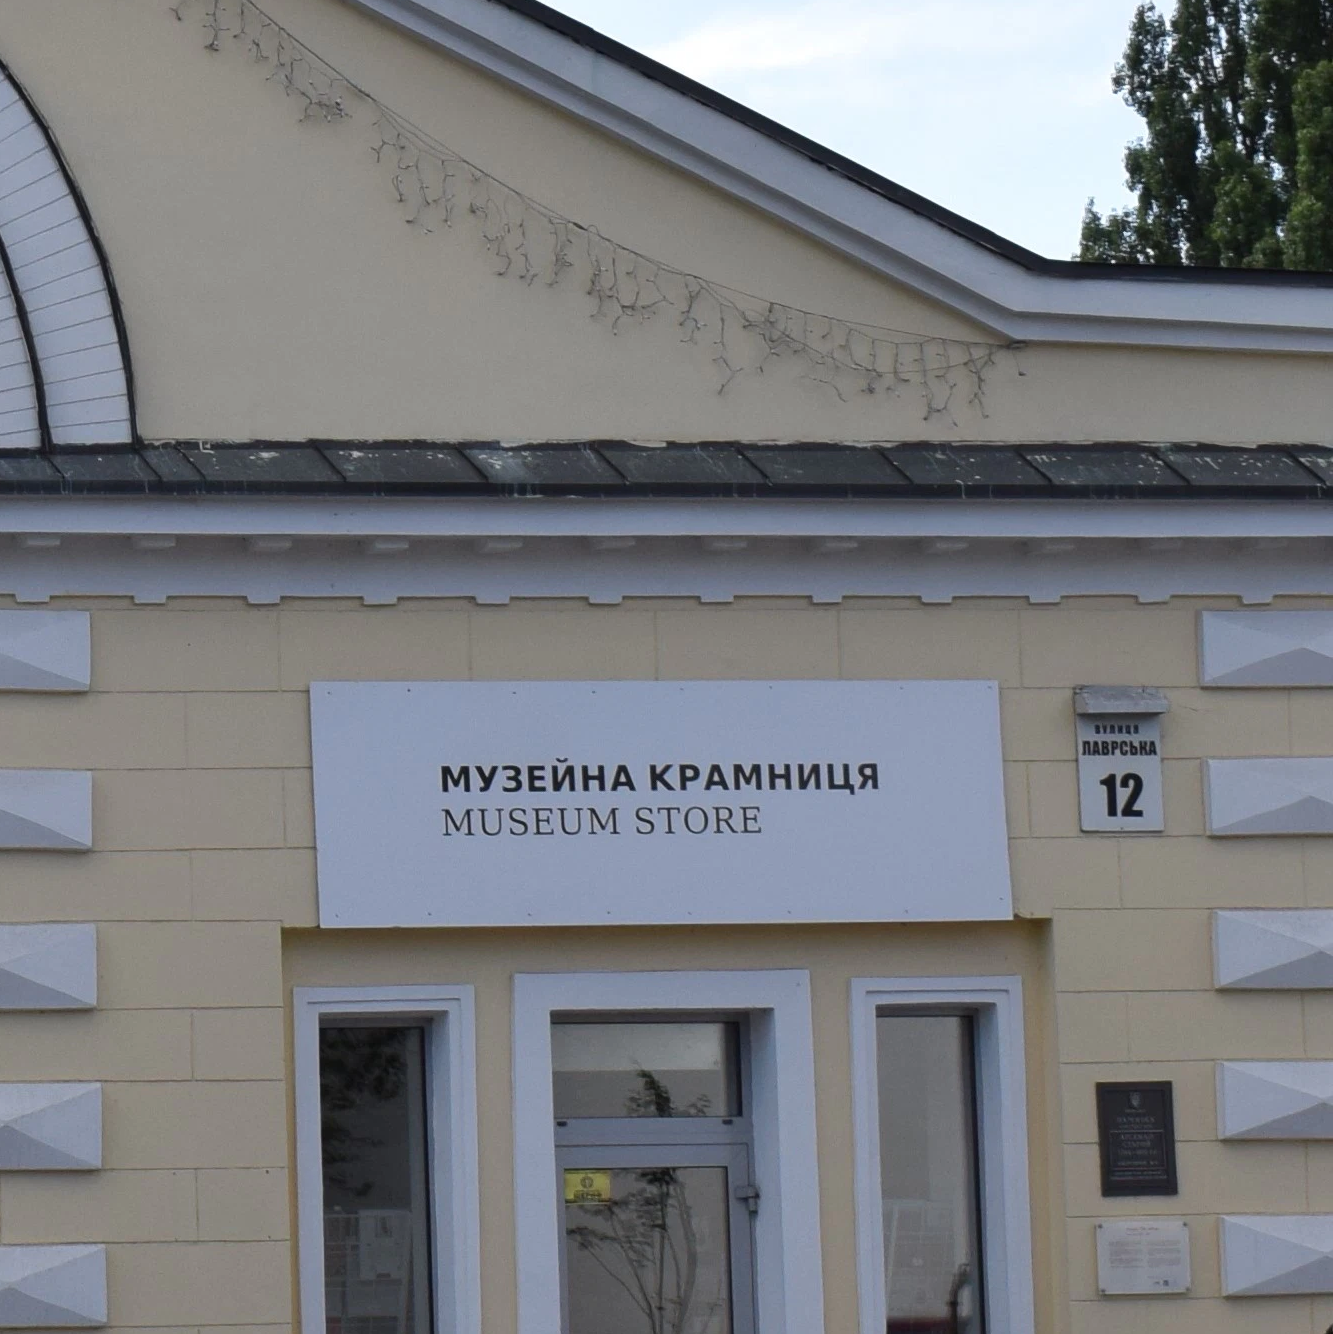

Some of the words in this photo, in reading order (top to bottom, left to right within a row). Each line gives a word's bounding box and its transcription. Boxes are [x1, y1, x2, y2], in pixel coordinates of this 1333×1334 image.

[1082, 740, 1158, 756] ЛАВРСЬКА
[440, 758, 636, 792] МУЗЕЙНА
[649, 763, 879, 795] КРАМНИЦЯ
[1099, 772, 1144, 818] 12
[441, 807, 620, 836] MUSEUM
[635, 806, 762, 835] STORE
